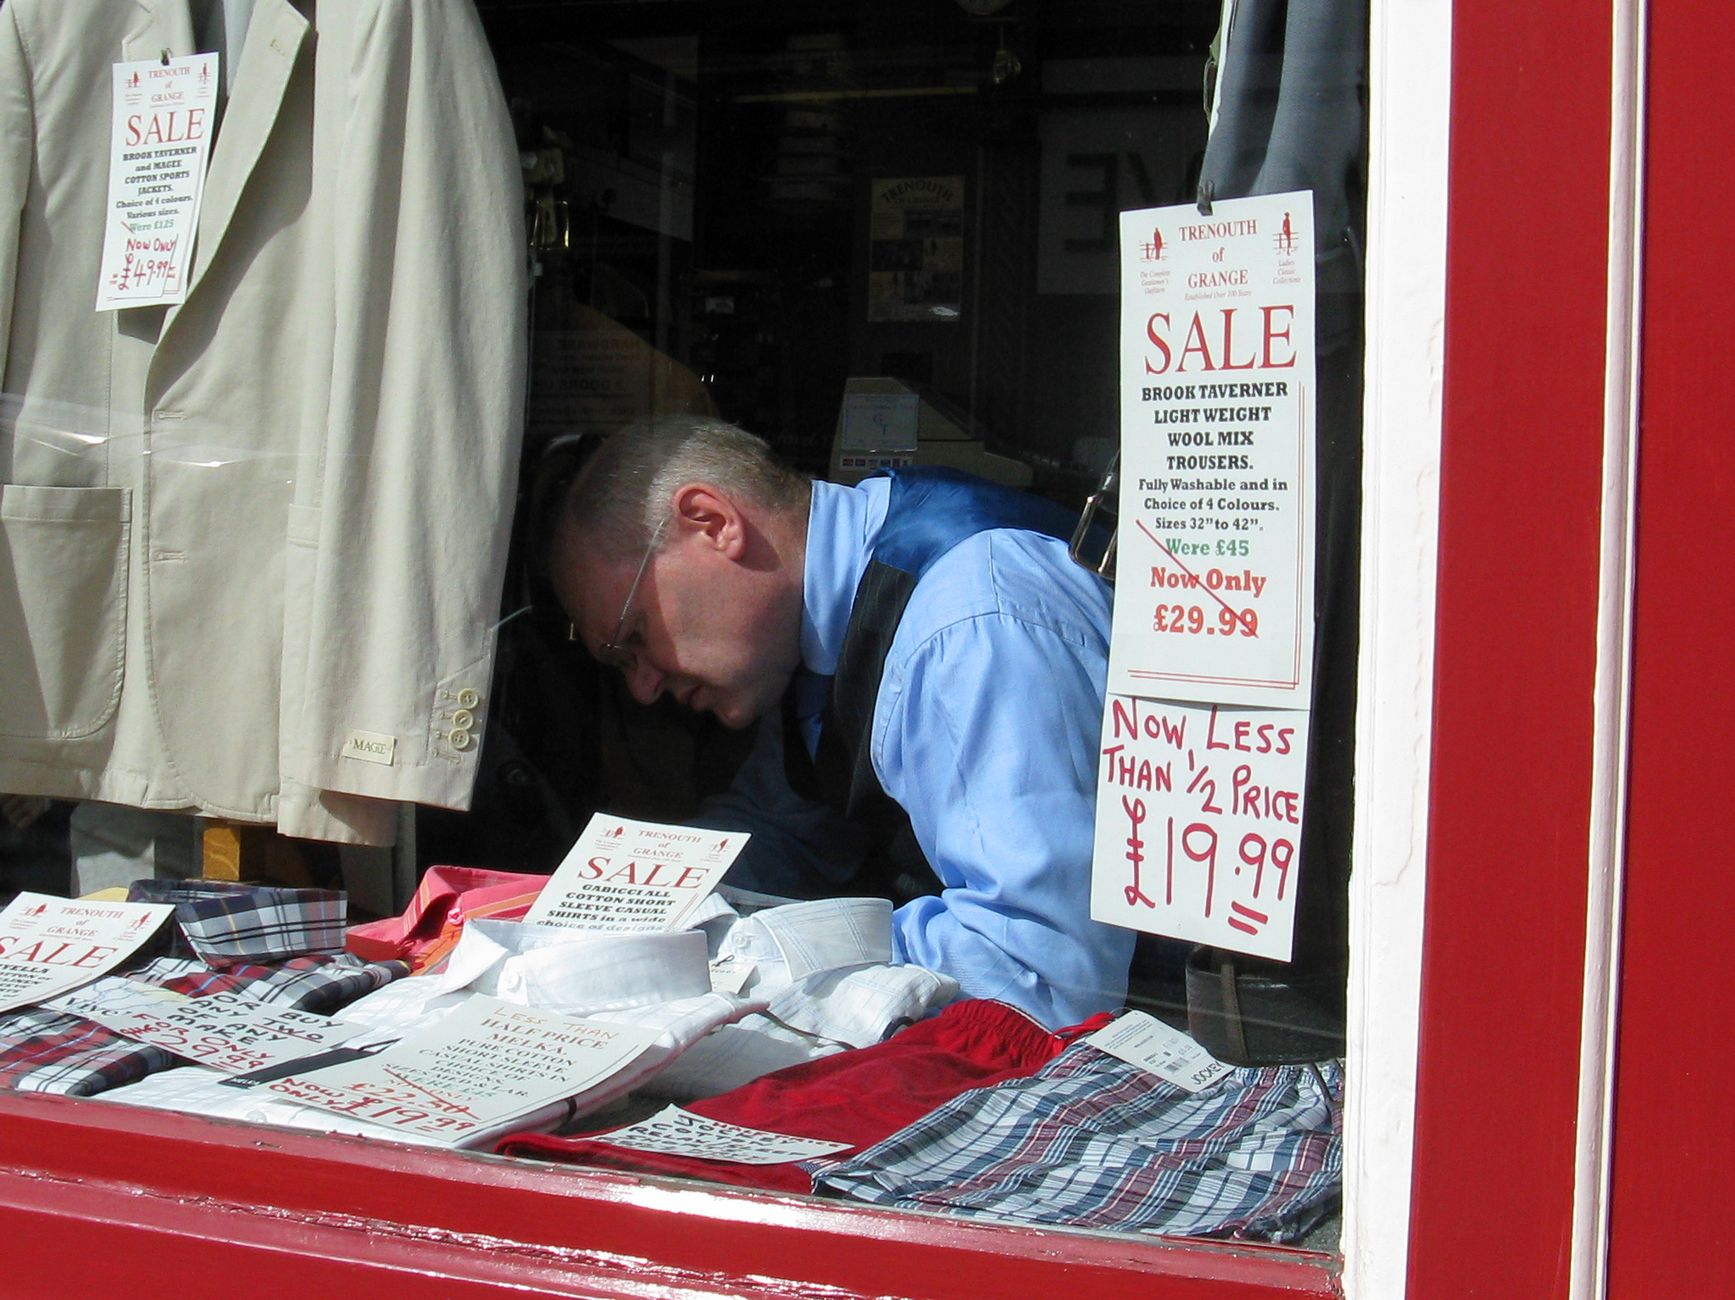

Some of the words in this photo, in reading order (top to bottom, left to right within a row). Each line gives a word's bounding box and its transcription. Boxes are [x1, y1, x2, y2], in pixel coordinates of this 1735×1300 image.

[149, 67, 190, 78] TRENOUTH
[126, 108, 205, 147] SALE
[123, 152, 153, 161] BROOK
[154, 146, 197, 158] TAVERNER
[135, 163, 152, 171] and
[125, 174, 157, 184] COTTON
[159, 170, 190, 181] SPORTS
[116, 200, 143, 208] Choice
[1179, 220, 1257, 242] TRENOUTH
[1212, 247, 1225, 262] of
[1187, 269, 1249, 289] GRANGE
[1145, 305, 1297, 376] SALE
[1142, 385, 1196, 402] BROOK
[1199, 382, 1288, 400] TAVERNER
[1154, 409, 1200, 424] LIGHT
[1203, 407, 1272, 423] WEIGHT
[1167, 432, 1214, 447] WOOL
[1217, 431, 1254, 446] MIX
[1167, 455, 1254, 471] TROUSERS.
[1138, 479, 1169, 493] Fully
[1170, 479, 1236, 491] Washable
[1240, 479, 1269, 491] and
[1273, 478, 1288, 491] in
[1144, 498, 1187, 511] Choice
[1190, 498, 1204, 511] of
[1206, 498, 1214, 511] 4
[1217, 498, 1280, 512] Colours.
[1155, 518, 1187, 530] Sizes
[1215, 518, 1229, 530] to
[1165, 538, 1211, 555] Were
[1215, 538, 1250, 557] £45
[1151, 566, 1200, 590] Now
[1206, 568, 1267, 598] Only
[1153, 604, 1260, 638] £29.99
[1206, 703, 1295, 755] LESS
[1102, 745, 1172, 793] THAN
[1232, 764, 1300, 825] PRICE
[639, 830, 702, 843] TRENOUTH
[633, 848, 684, 859] GRANGE
[1122, 794, 1295, 919] £19.99
[577, 856, 711, 889] SALE
[566, 892, 625, 903] COTTON
[626, 898, 676, 906] SHORT
[582, 884, 643, 897] GABICCI
[60, 907, 124, 918] TRENOUTH
[547, 910, 599, 921] SHIRTS
[559, 901, 613, 913] SLEEVE
[615, 906, 668, 914] CASUAL
[47, 926, 98, 937] GRANGE
[536, 920, 585, 930] choice
[190, 1000, 248, 1016] ANY
[263, 1017, 324, 1040] TWO
[213, 995, 261, 1010] OR
[278, 1012, 344, 1028] BUY
[167, 1014, 259, 1045] MAKE
[177, 1007, 218, 1019] OF
[225, 1023, 288, 1040] ANY
[494, 1006, 548, 1024] LESS
[563, 1022, 619, 1040] THAN
[132, 1013, 189, 1035] FOR
[200, 1037, 275, 1059] ONLY
[481, 1018, 541, 1035] HALF
[542, 1031, 608, 1050] PRICE
[442, 1045, 502, 1060] SHORT
[504, 1057, 567, 1073] SLEEVE
[458, 1039, 502, 1051] PURE
[505, 1048, 576, 1066] COTTON
[419, 1049, 482, 1064] CASUAL
[486, 1062, 547, 1078] SHIRTS
[435, 1060, 498, 1075] CHOICE
[269, 1085, 344, 1106] ONLY
[281, 1078, 345, 1098] NOW
